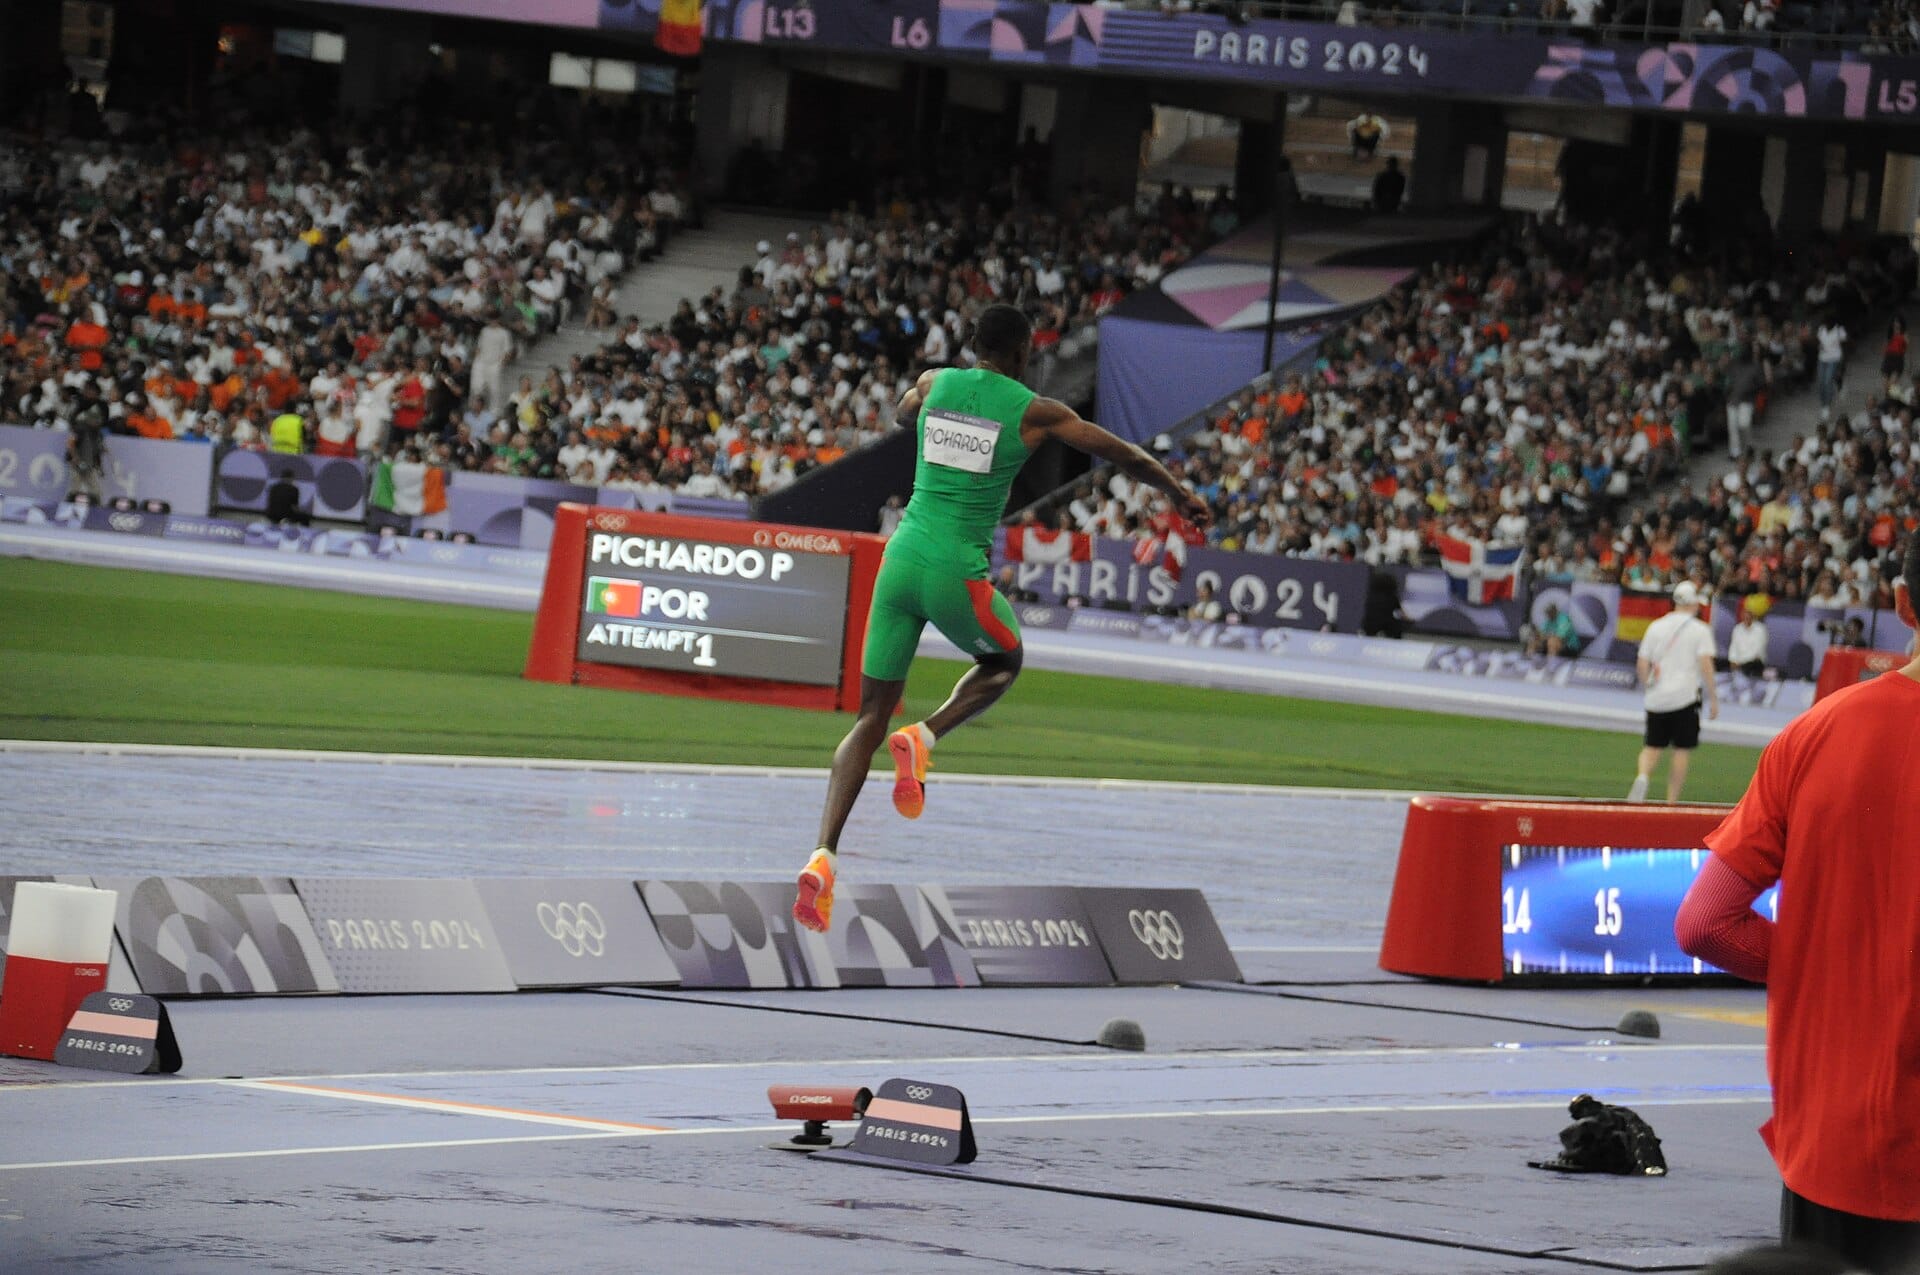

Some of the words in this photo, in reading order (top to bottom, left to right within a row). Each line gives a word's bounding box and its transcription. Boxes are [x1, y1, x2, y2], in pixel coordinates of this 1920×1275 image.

[766, 6, 816, 39] L13
[891, 15, 930, 48] L6
[1323, 40, 1429, 77] 2024
[1878, 79, 1917, 112] L5
[0, 447, 136, 497] 204
[590, 533, 766, 579] PICHARDO
[771, 552, 795, 582] P
[774, 532, 842, 553] OMEGA
[640, 585, 710, 621] POR
[586, 622, 699, 654] ATTEMPT
[693, 633, 717, 667] 1
[1502, 885, 1533, 934] 14
[1594, 887, 1623, 936] 15
[411, 918, 486, 950] 2024
[1032, 919, 1091, 948] 2024
[108, 1042, 144, 1056] 2024
[910, 1131, 949, 1148] 2024
